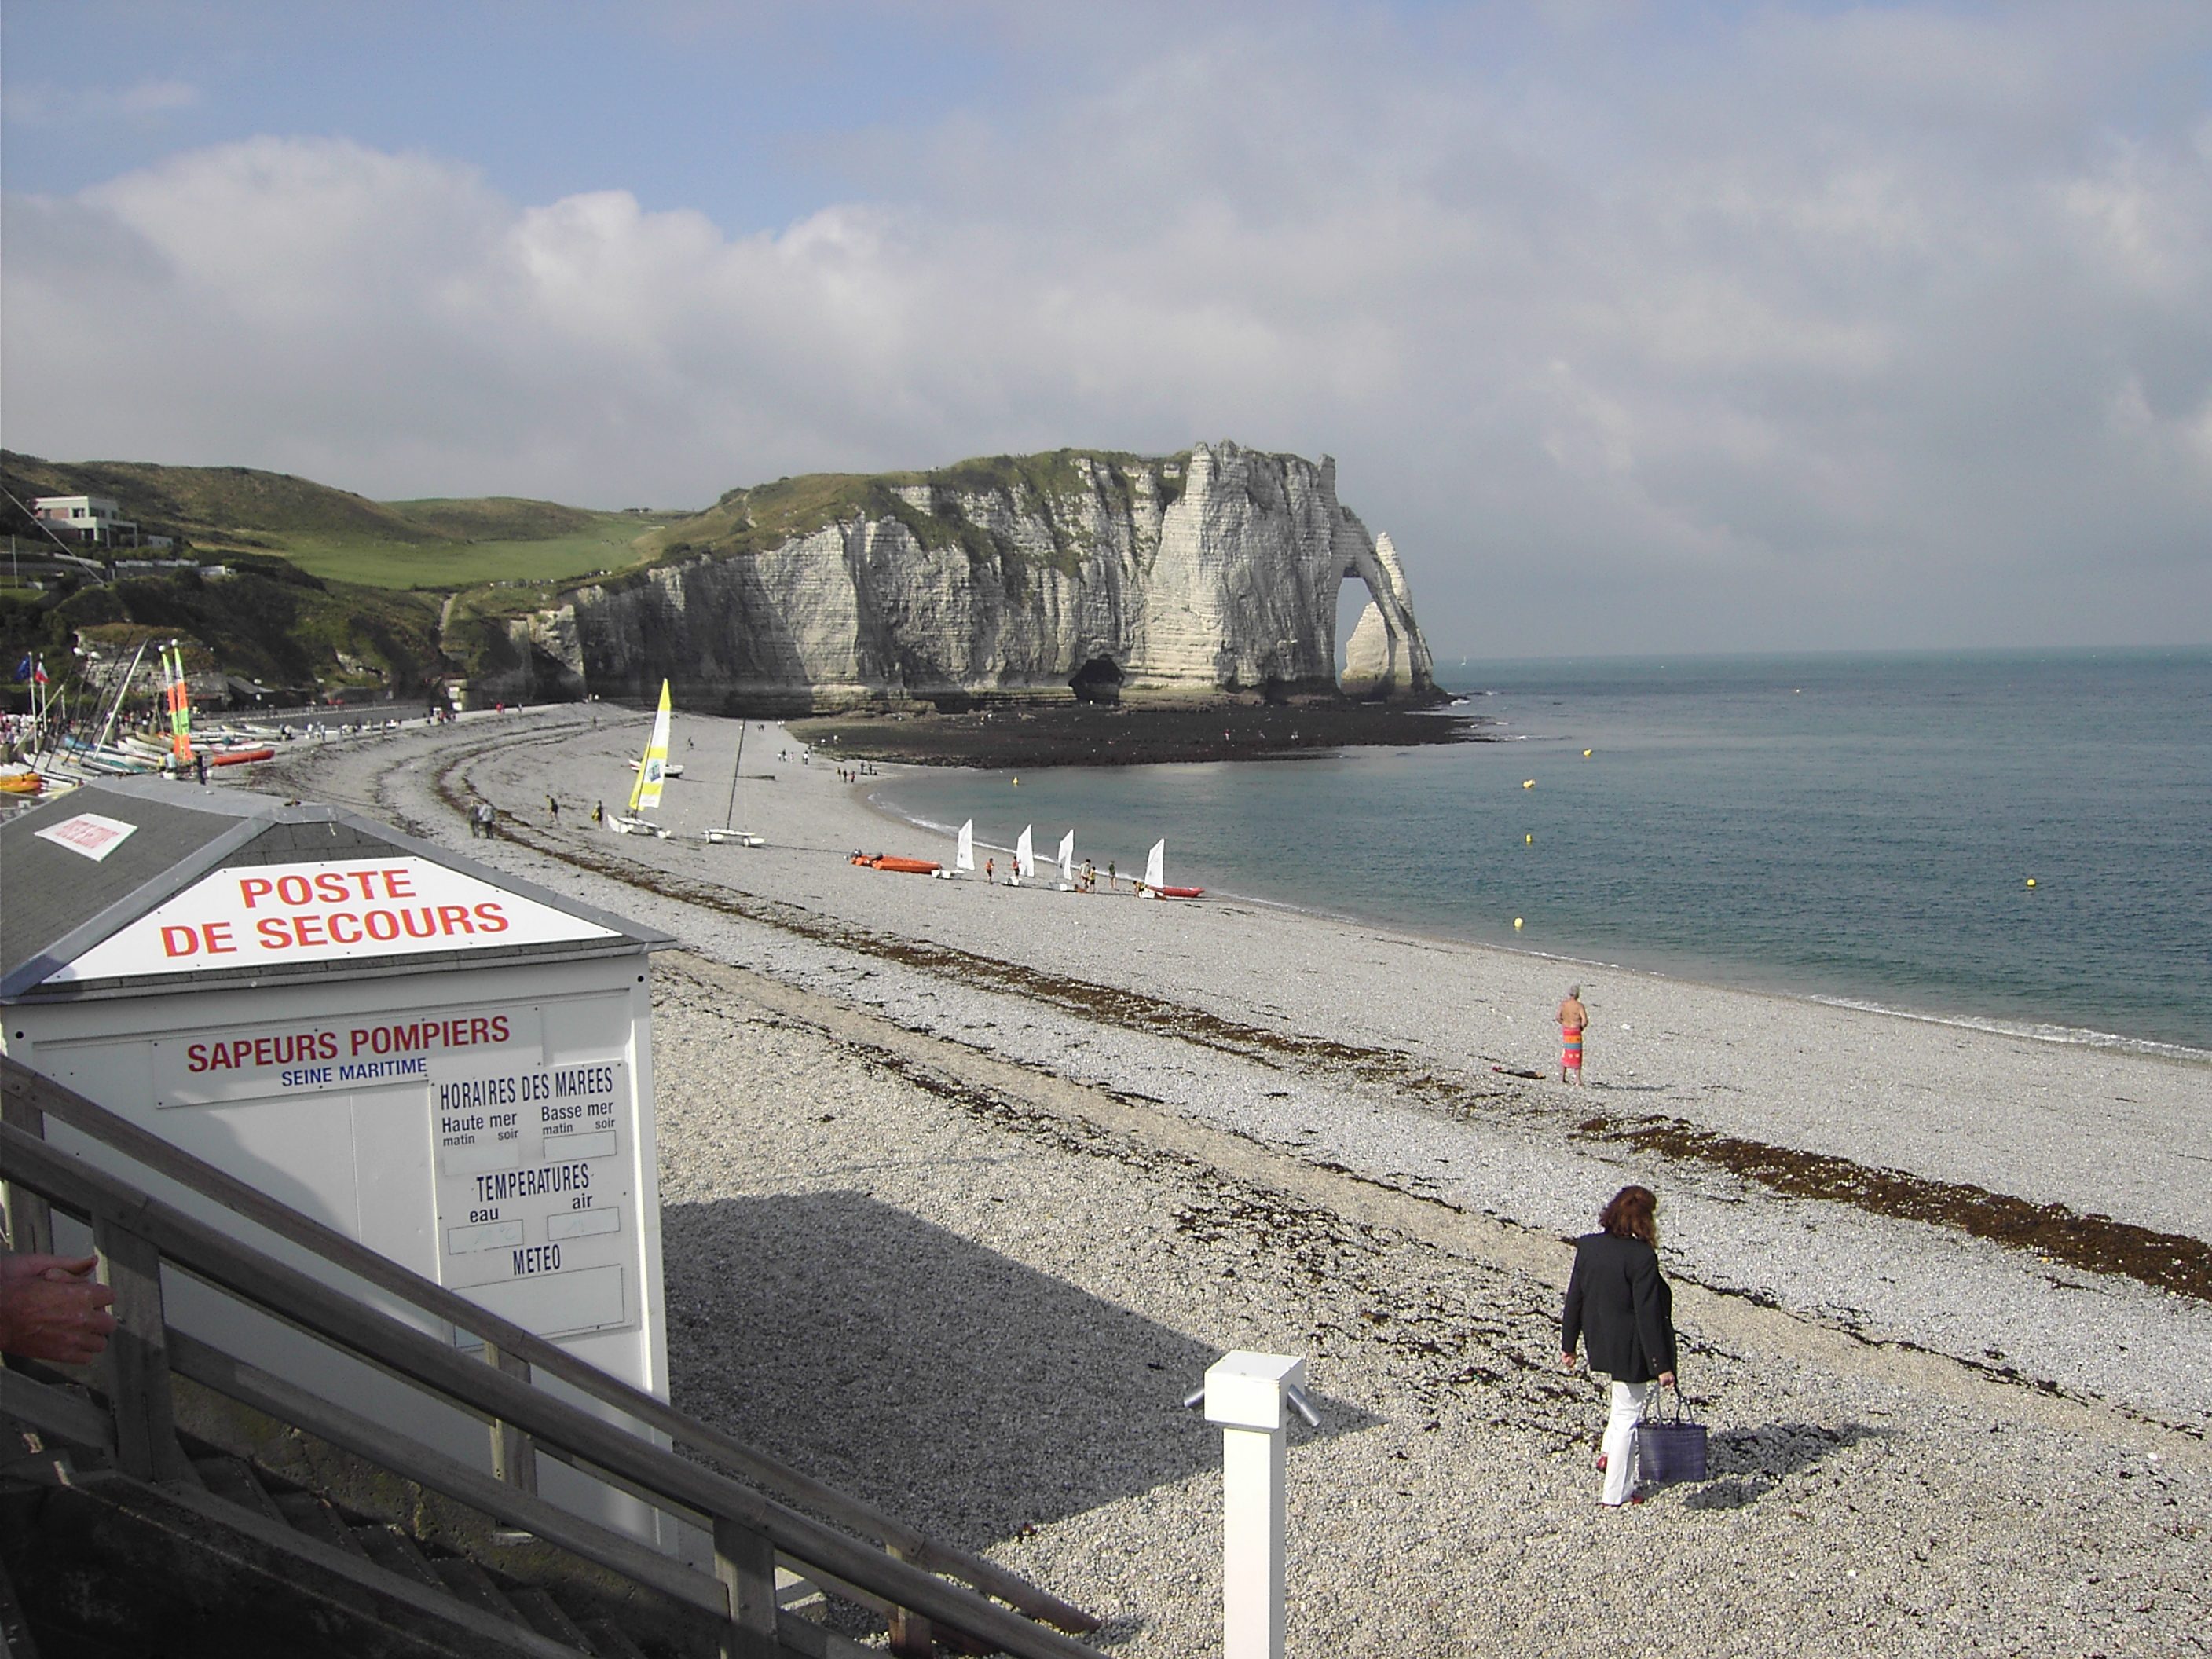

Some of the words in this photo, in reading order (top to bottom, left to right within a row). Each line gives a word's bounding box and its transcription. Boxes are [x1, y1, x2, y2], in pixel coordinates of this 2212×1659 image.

[240, 869, 417, 909] POSTE
[159, 921, 238, 958] DE
[256, 903, 509, 950] SECOURS
[187, 1031, 339, 1073] SAPEURS
[350, 1016, 511, 1057] POMPIERS
[281, 1068, 333, 1086] SEINE
[339, 1057, 427, 1081] MARITIME
[440, 1077, 516, 1111] HORAIRES
[522, 1073, 550, 1102] DES
[555, 1067, 613, 1098] MAREES
[442, 1115, 484, 1133] Haute
[489, 1112, 518, 1129] mer
[541, 1104, 582, 1122] Basse
[587, 1101, 614, 1117] mer
[442, 1133, 475, 1147] matin
[497, 1129, 519, 1141] soir
[542, 1122, 573, 1136] matin
[595, 1117, 616, 1130] soir
[476, 1163, 590, 1203] TEMPERATURES
[469, 1207, 500, 1223] eau
[572, 1192, 593, 1210] air
[512, 1243, 561, 1276] METEO
